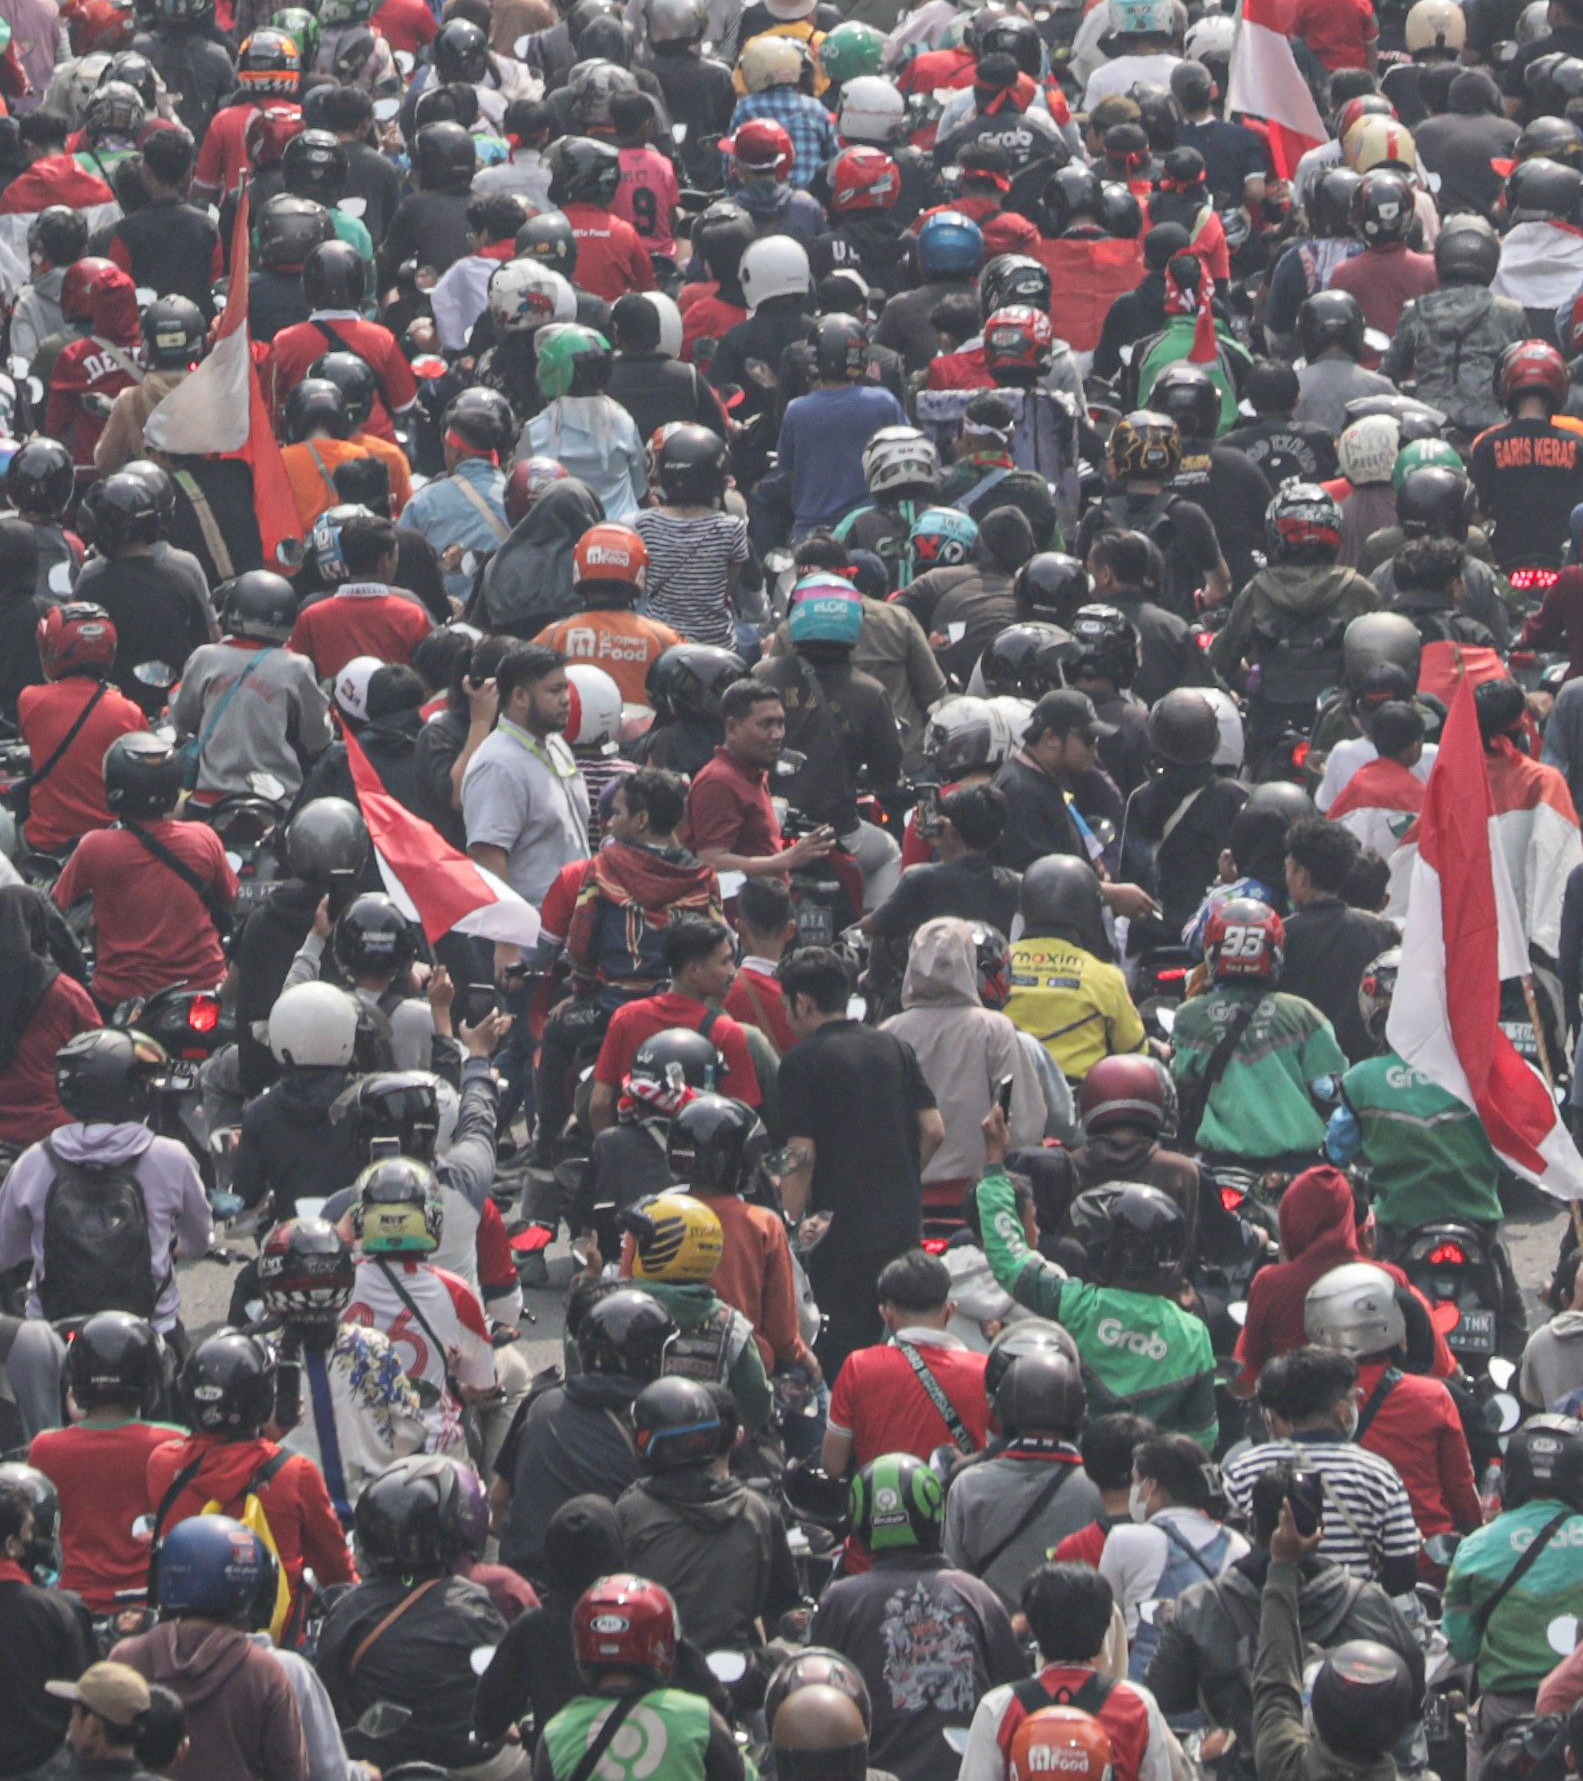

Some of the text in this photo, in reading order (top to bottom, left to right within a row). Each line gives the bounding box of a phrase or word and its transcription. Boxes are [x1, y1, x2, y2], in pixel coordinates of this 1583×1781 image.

[977, 126, 1034, 150] Grab
[631, 186, 658, 237] 9
[1493, 438, 1577, 470] GARIS KERAS
[598, 643, 648, 662] Food
[1220, 925, 1266, 958] 93
[1012, 952, 1084, 969] maxim
[1097, 1316, 1169, 1361] Grab
[1049, 1757, 1090, 1772] Food
